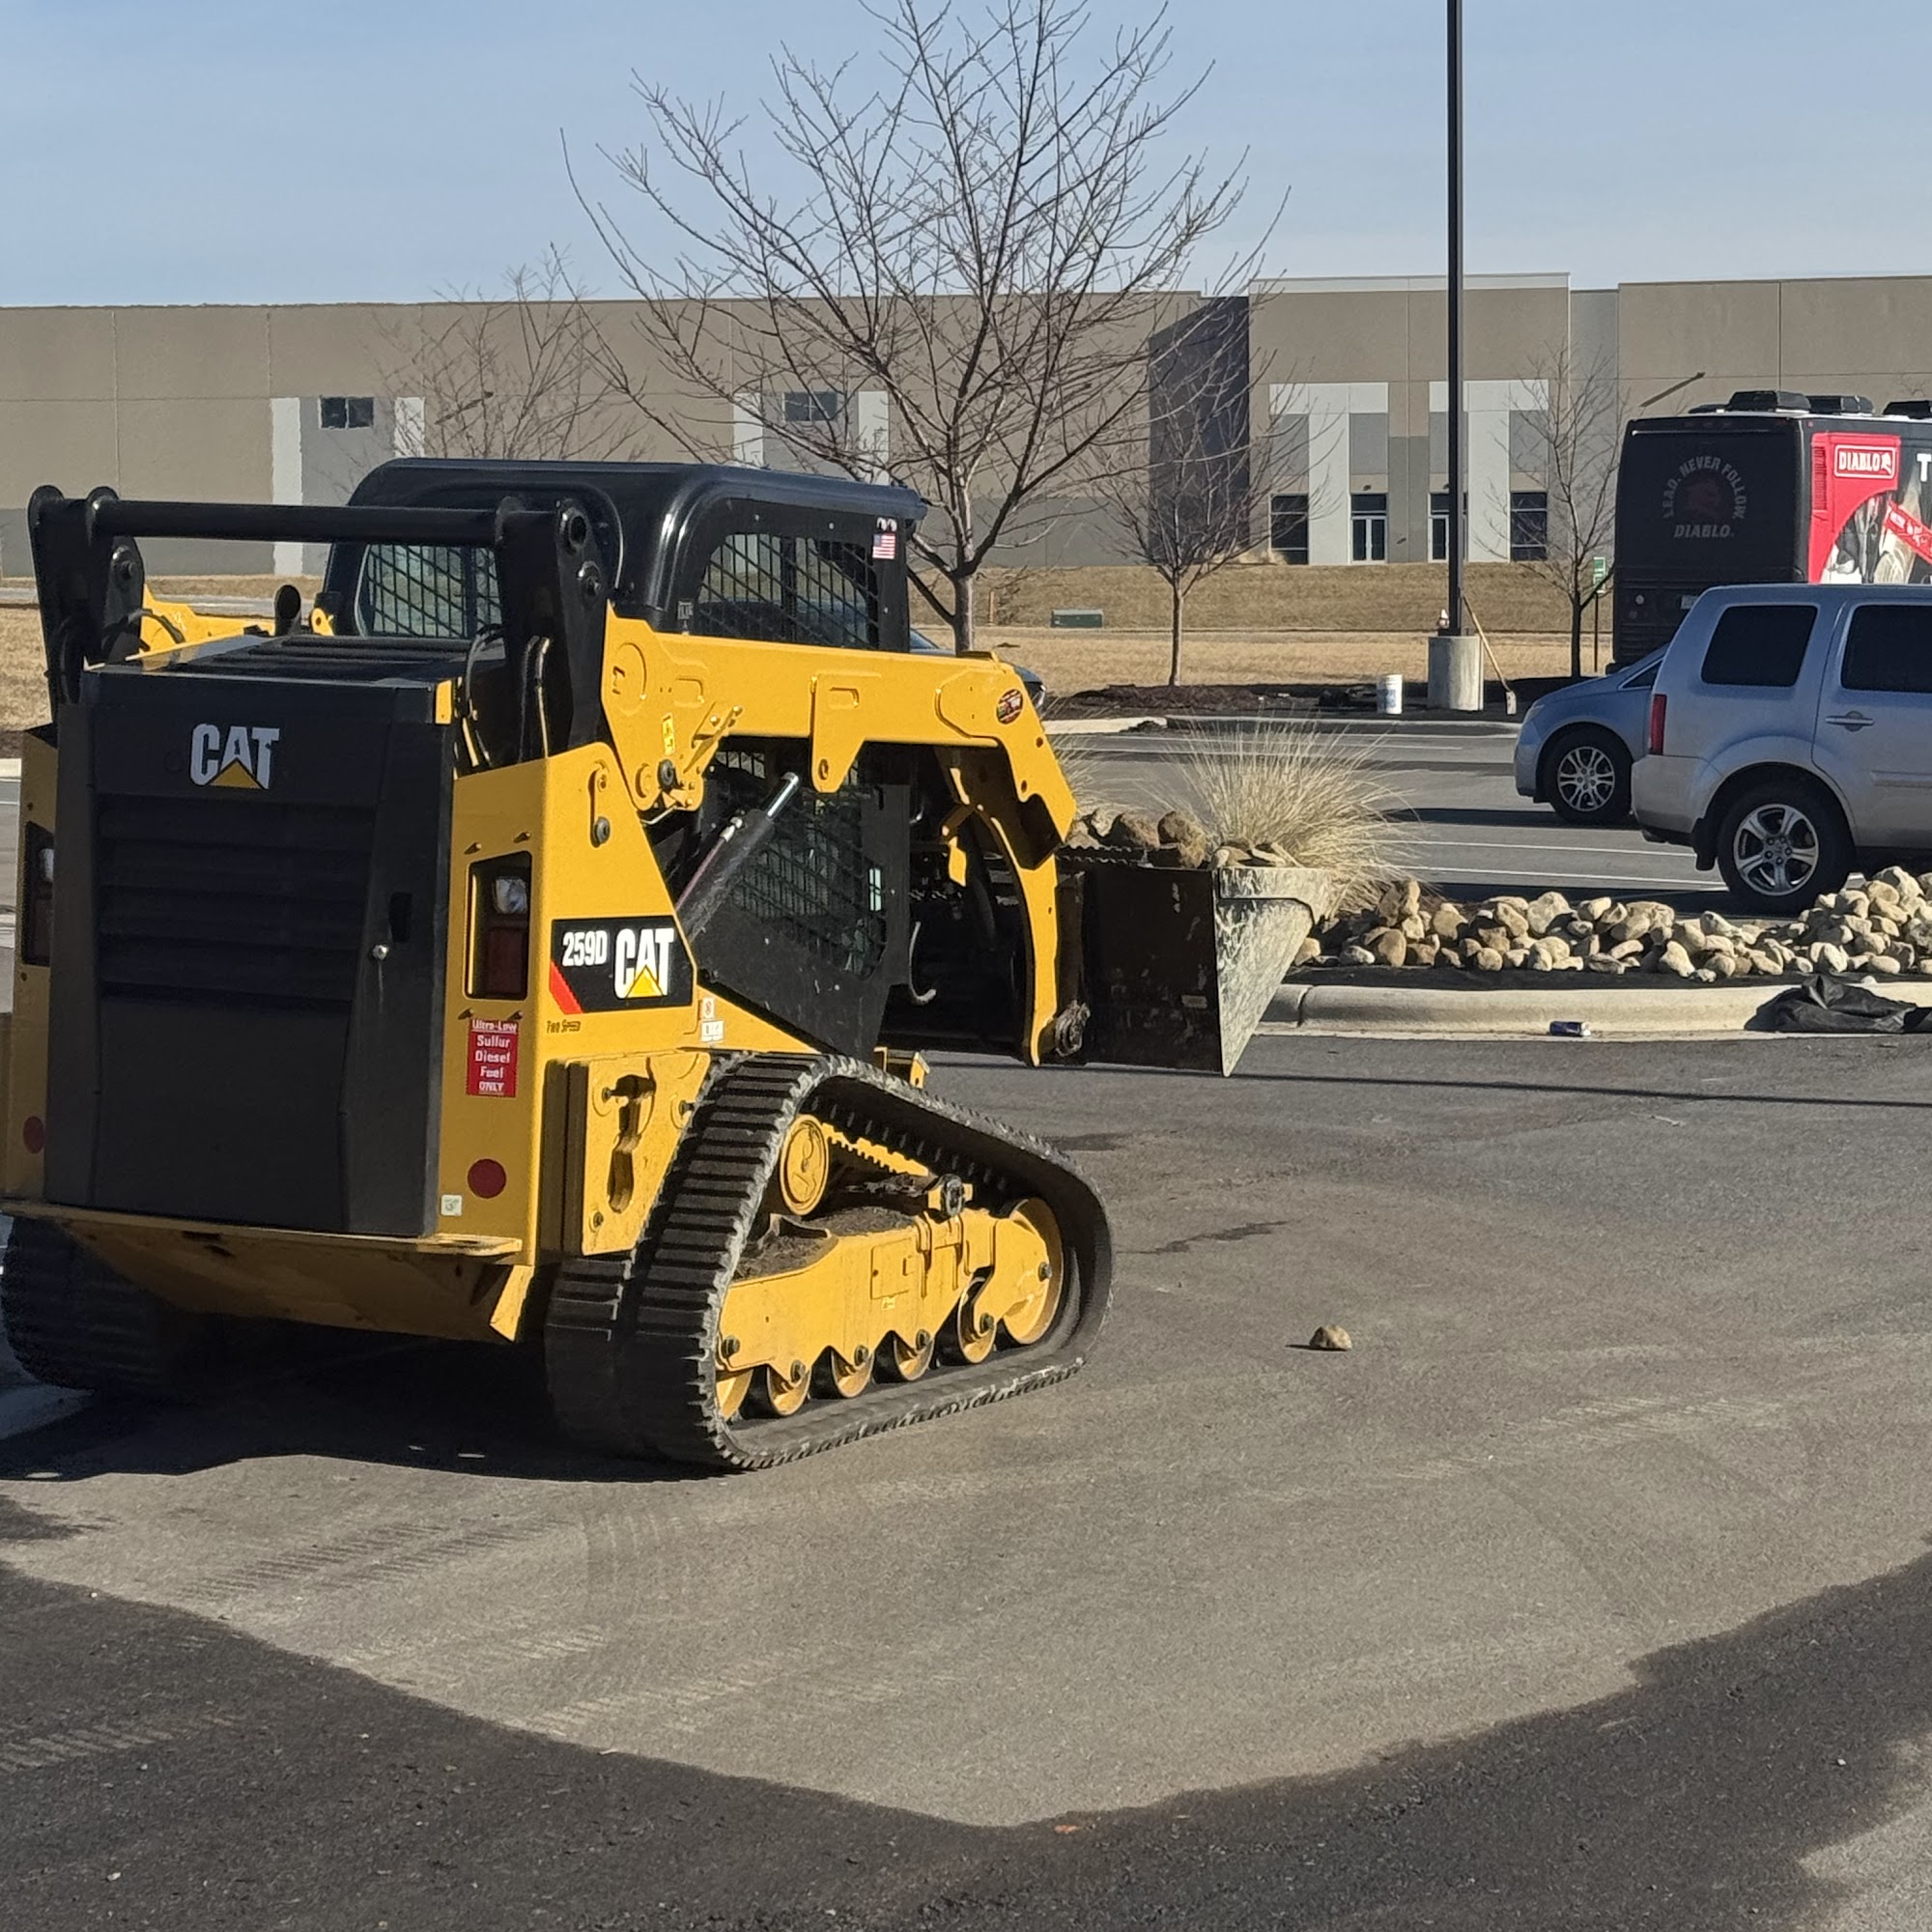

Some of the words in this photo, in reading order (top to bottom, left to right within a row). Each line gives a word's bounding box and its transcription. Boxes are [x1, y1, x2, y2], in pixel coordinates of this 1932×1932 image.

[1679, 456, 1721, 477] NEVER
[1839, 451, 1880, 471] DIABLO
[190, 724, 280, 789] CAT
[561, 930, 608, 967] 259D
[613, 927, 674, 999] CAT
[476, 1035, 511, 1048] Sulfur
[474, 1050, 510, 1063] Diesel
[480, 1066, 504, 1079] Fuel
